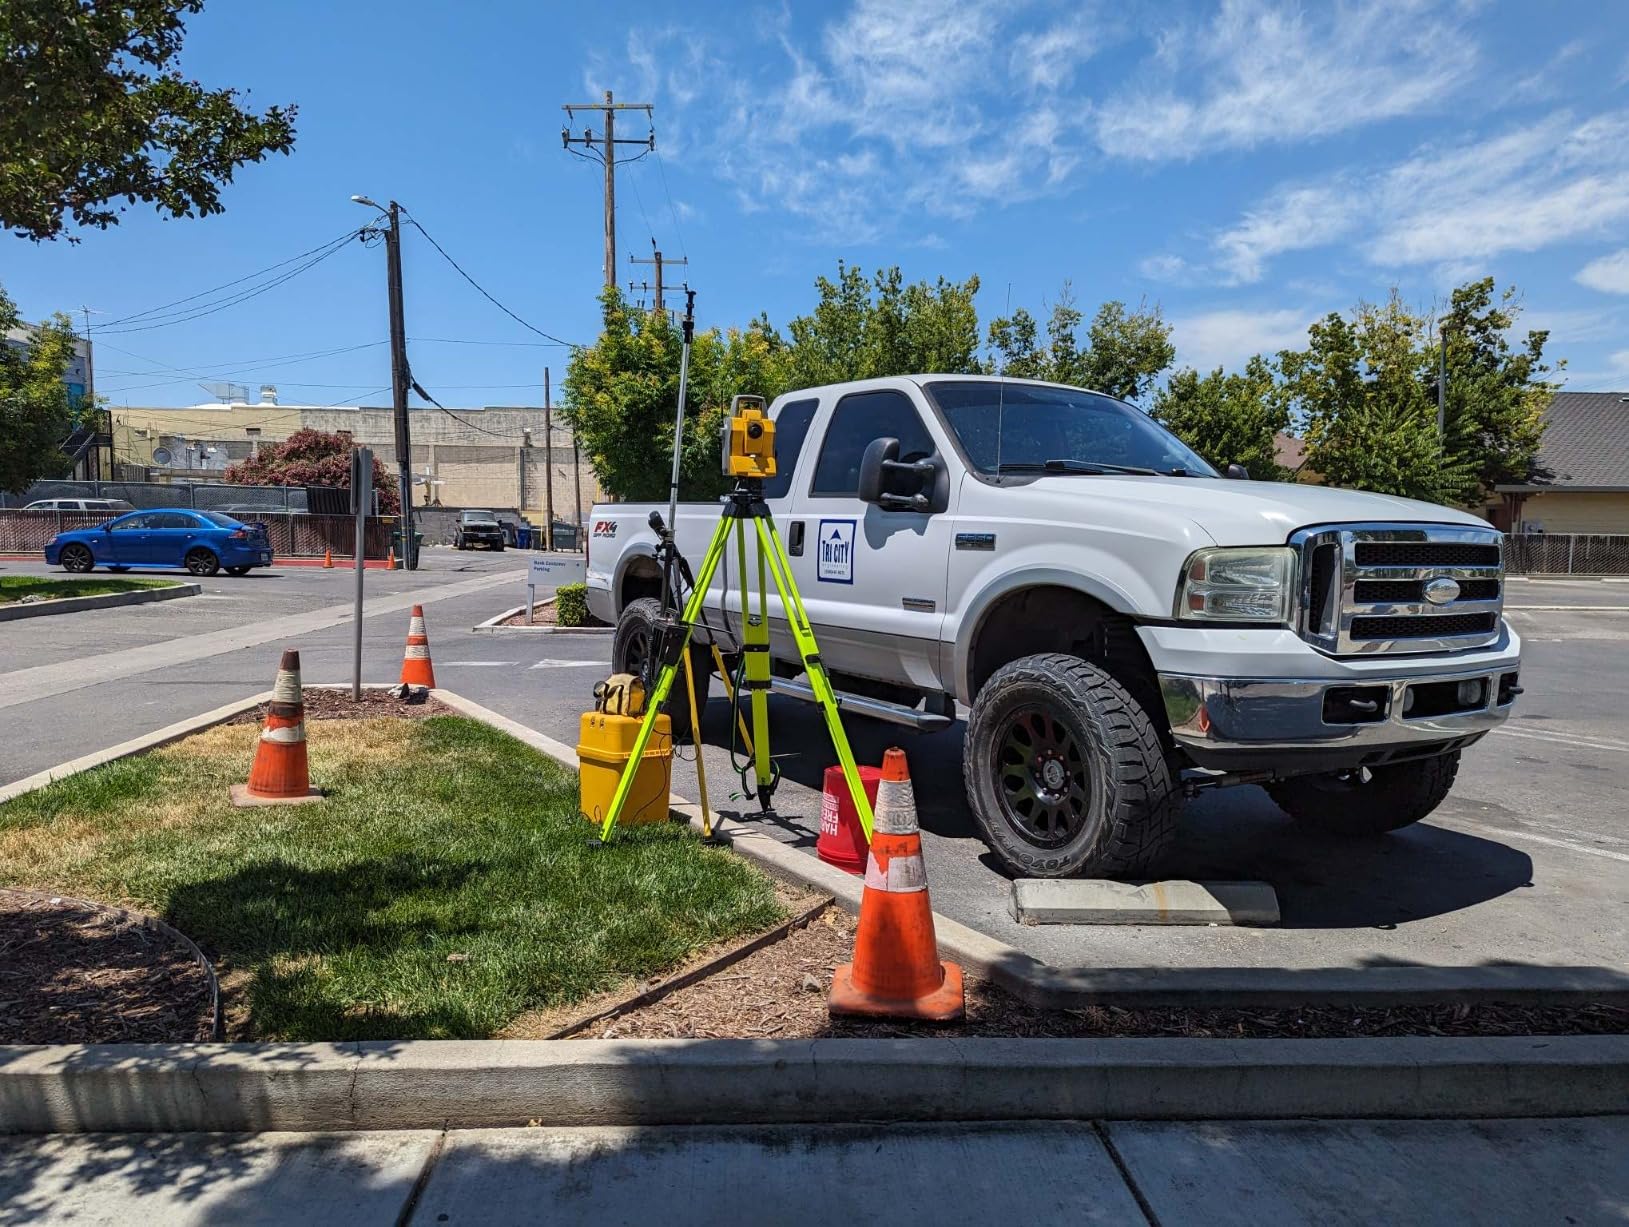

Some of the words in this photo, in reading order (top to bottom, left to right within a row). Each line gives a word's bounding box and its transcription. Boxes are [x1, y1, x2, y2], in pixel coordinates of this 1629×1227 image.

[594, 521, 617, 533] FX4
[822, 540, 832, 562] TRI
[834, 541, 849, 564] CITY
